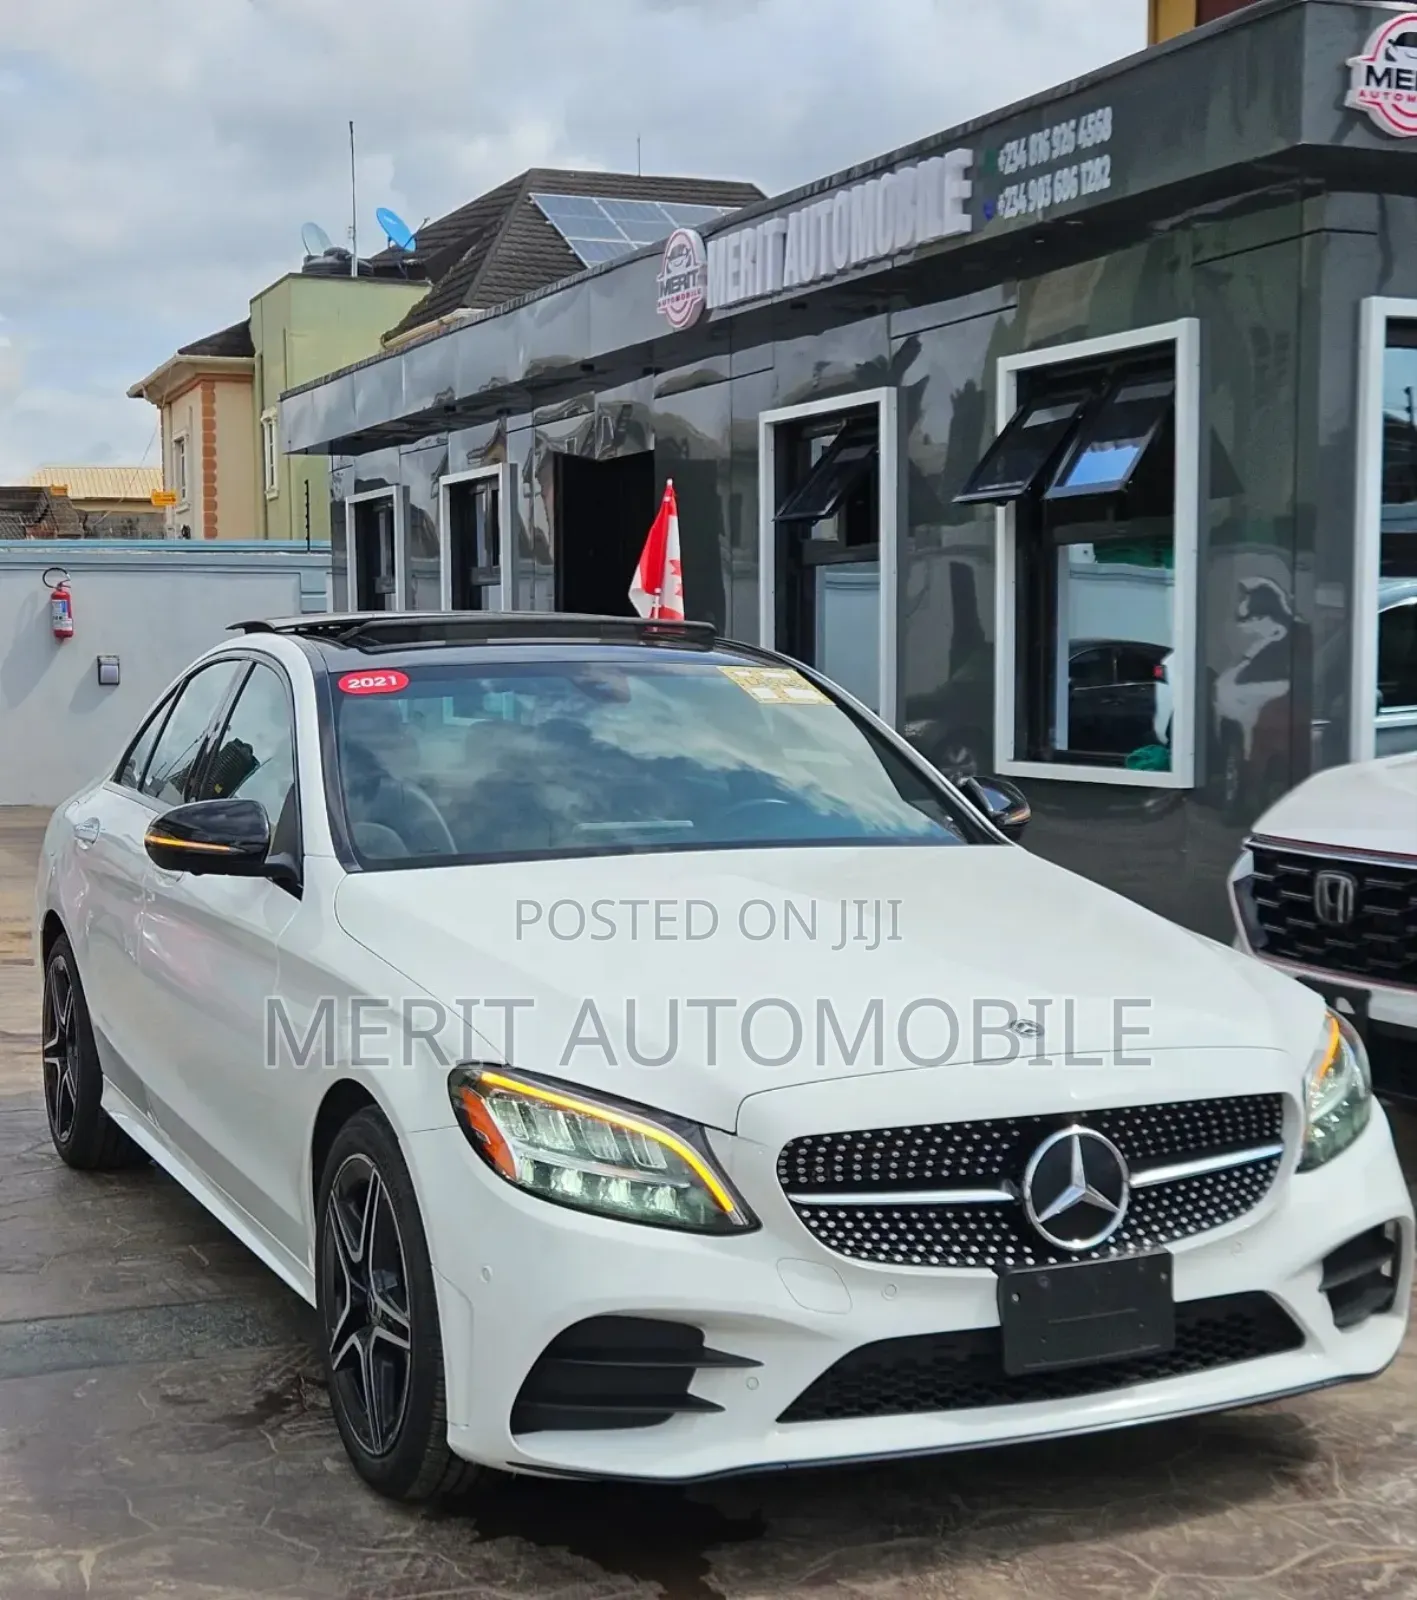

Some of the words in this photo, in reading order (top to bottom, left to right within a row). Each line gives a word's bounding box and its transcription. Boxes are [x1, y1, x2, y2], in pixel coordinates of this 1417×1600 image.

[1365, 65, 1417, 91] ME
[998, 137, 1027, 175] +234
[997, 182, 1027, 219] +234
[706, 217, 788, 309] MERIT
[784, 148, 973, 288] AUTOMOBILE
[660, 268, 699, 298] MERIT
[348, 675, 398, 689] 2021
